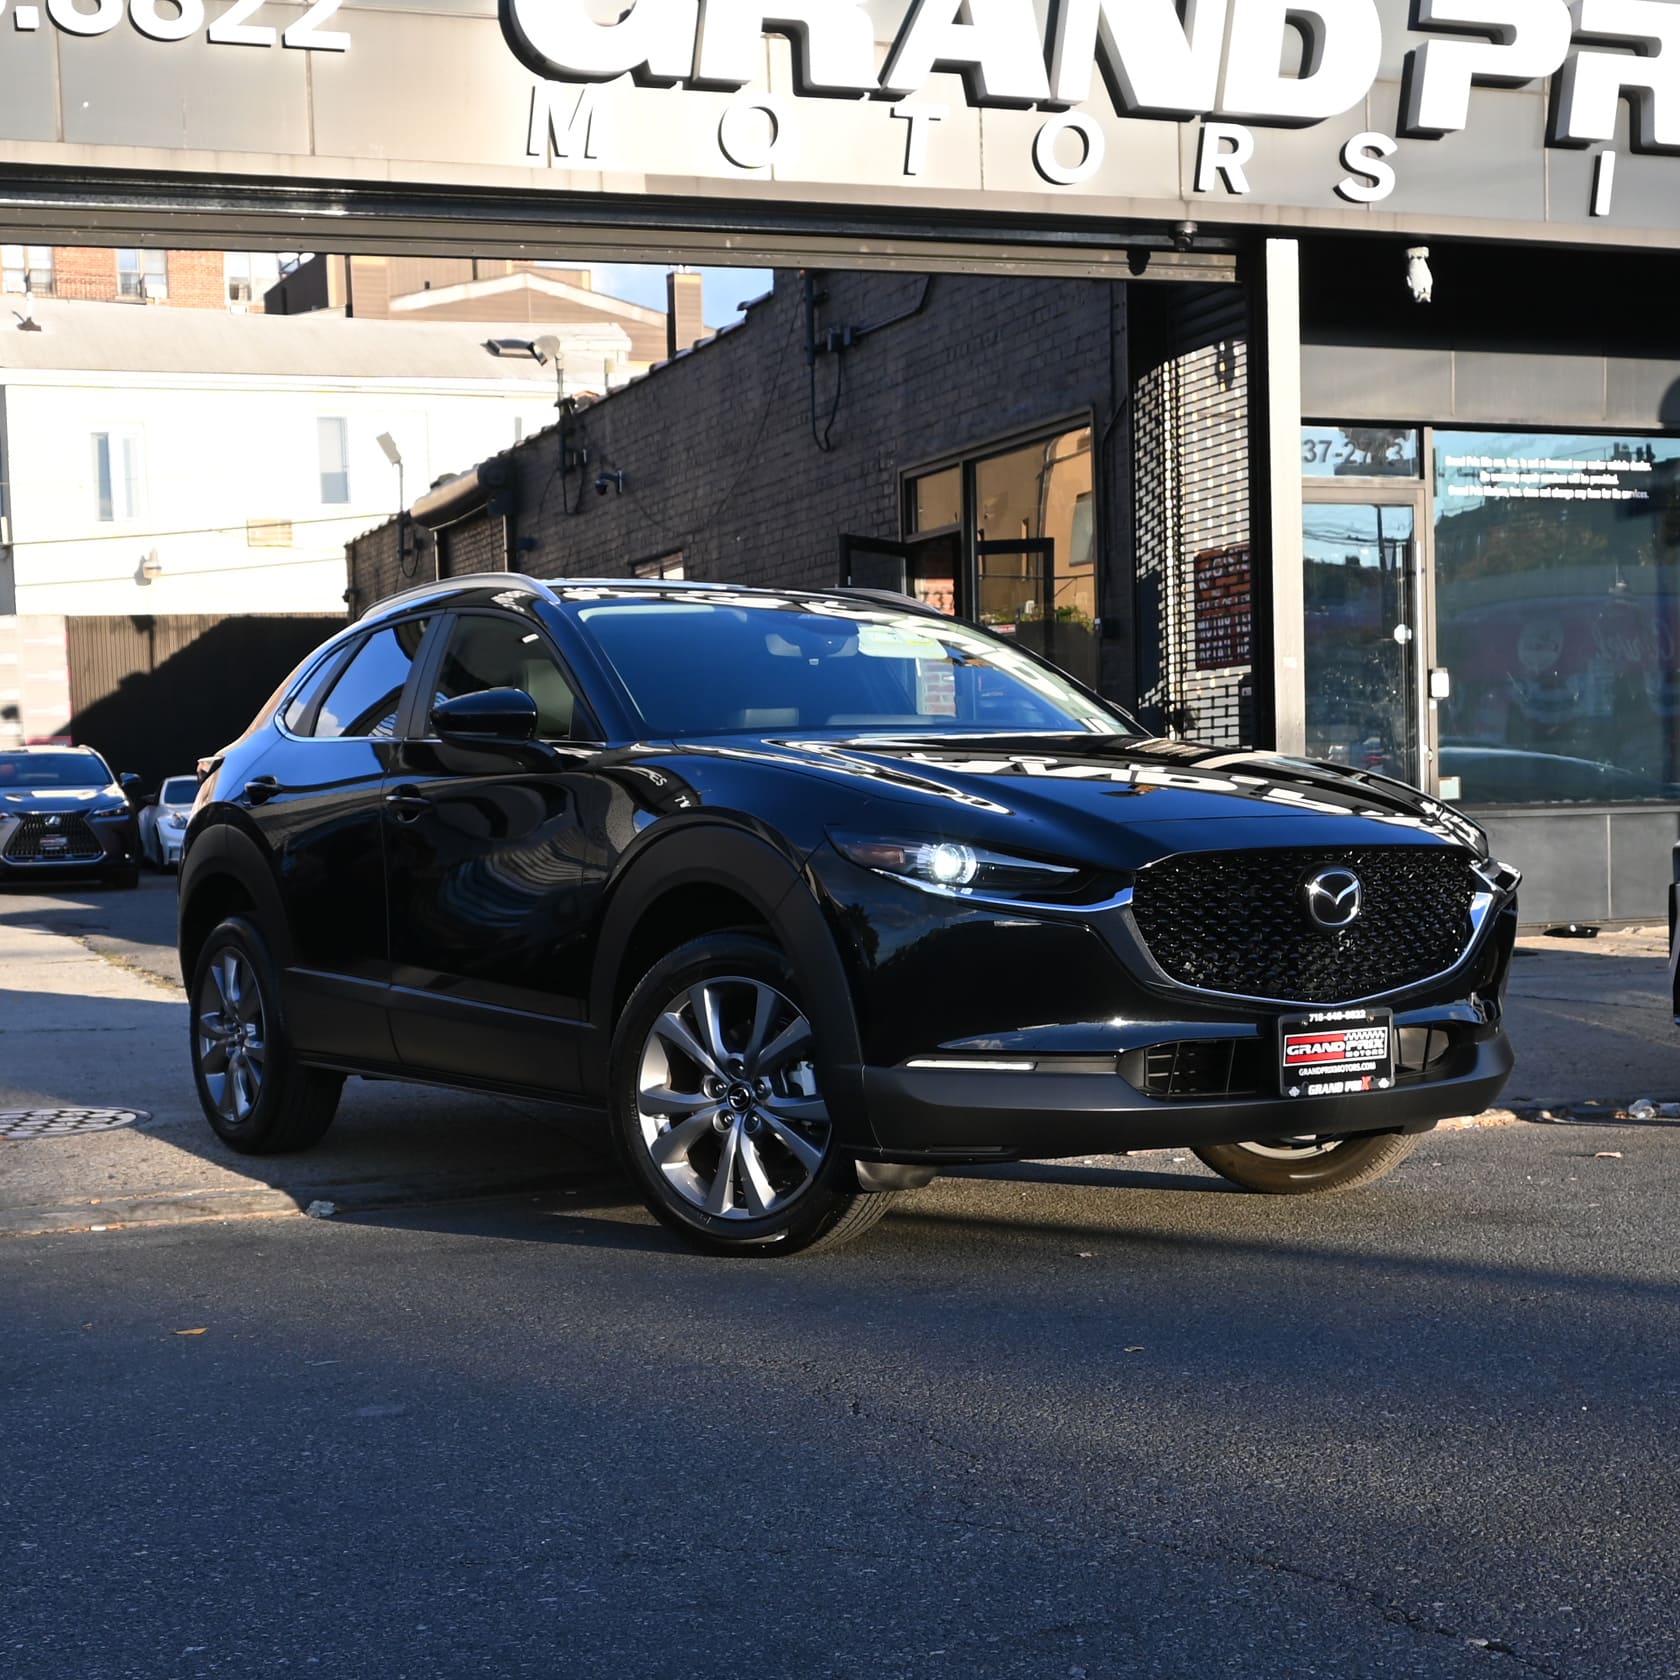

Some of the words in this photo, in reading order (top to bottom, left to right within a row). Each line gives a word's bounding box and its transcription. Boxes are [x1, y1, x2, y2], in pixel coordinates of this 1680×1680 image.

[524, 84, 1398, 203] MOTORS
[1287, 1041, 1346, 1056] GRAND
[1346, 1038, 1385, 1051] PRIX
[1308, 1081, 1344, 1096] GRAND
